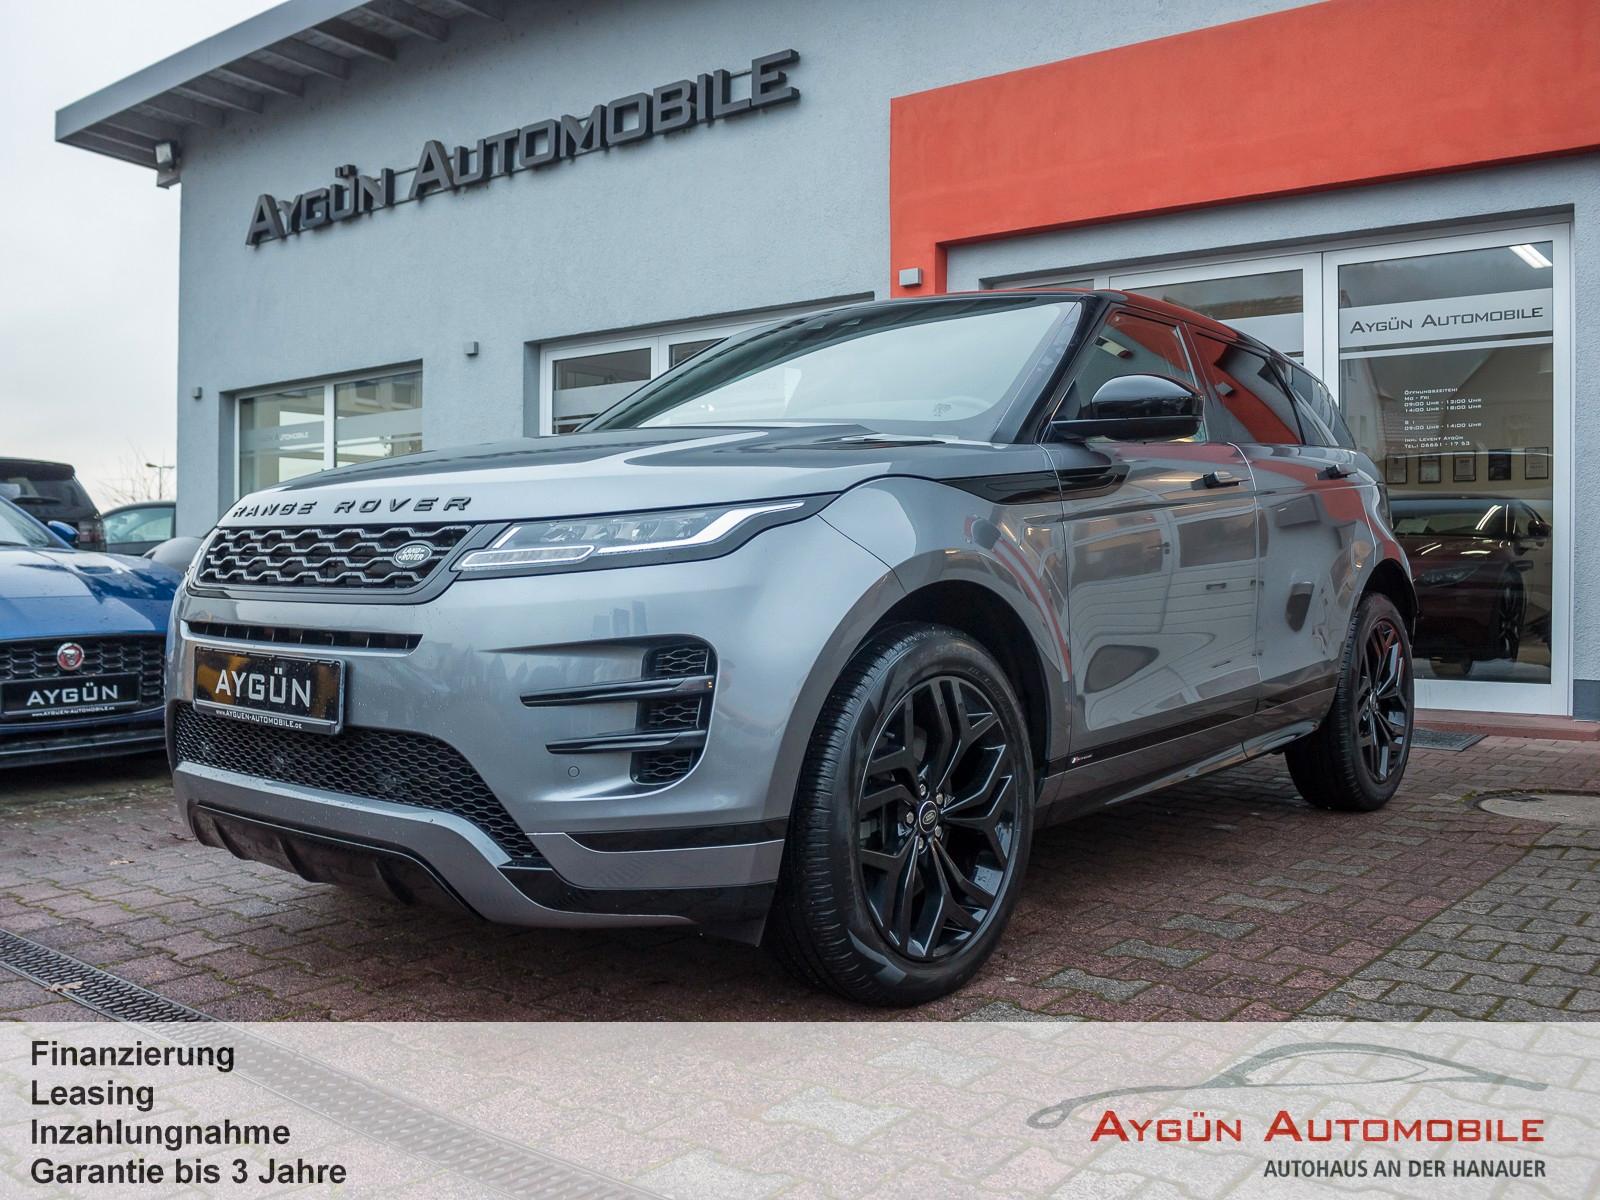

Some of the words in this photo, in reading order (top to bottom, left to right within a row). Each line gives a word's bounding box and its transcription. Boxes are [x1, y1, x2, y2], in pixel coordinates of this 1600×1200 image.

[245, 164, 394, 246] AYGÜN
[407, 48, 800, 200] AUTOMOBILE
[1350, 316, 1413, 334] AYGÜN
[1421, 307, 1543, 328] AUTOMOBILE
[232, 501, 317, 518] RANGE
[333, 496, 472, 514] ROVER
[26, 682, 118, 706] AYGÜN
[215, 667, 311, 708] AYGÜN
